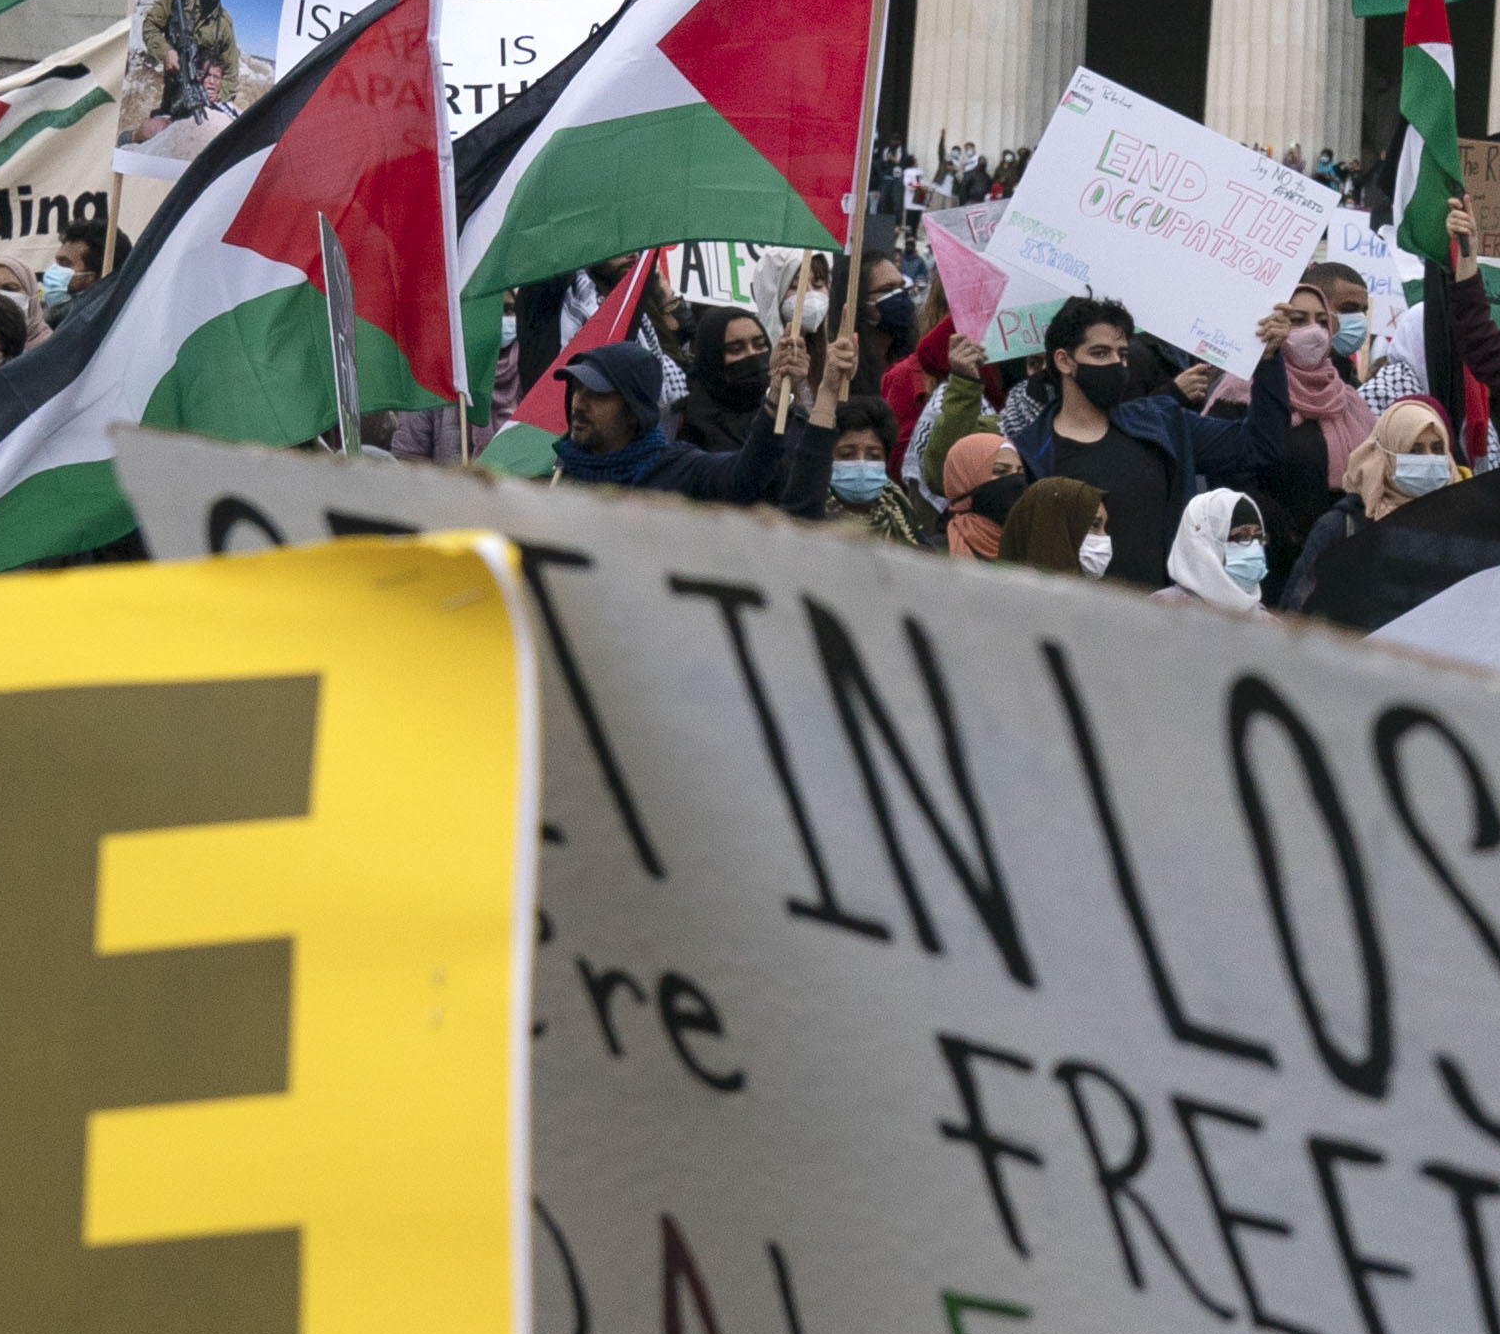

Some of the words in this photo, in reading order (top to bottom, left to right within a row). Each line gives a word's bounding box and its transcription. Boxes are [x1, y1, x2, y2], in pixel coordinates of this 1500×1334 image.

[500, 36, 537, 67] IS
[1096, 130, 1208, 203] END
[1223, 180, 1320, 258] THE
[1272, 166, 1292, 187] NO
[1020, 238, 1091, 283] ISRAEL
[1078, 178, 1283, 287] OCCUPATION
[669, 574, 1036, 992] IN
